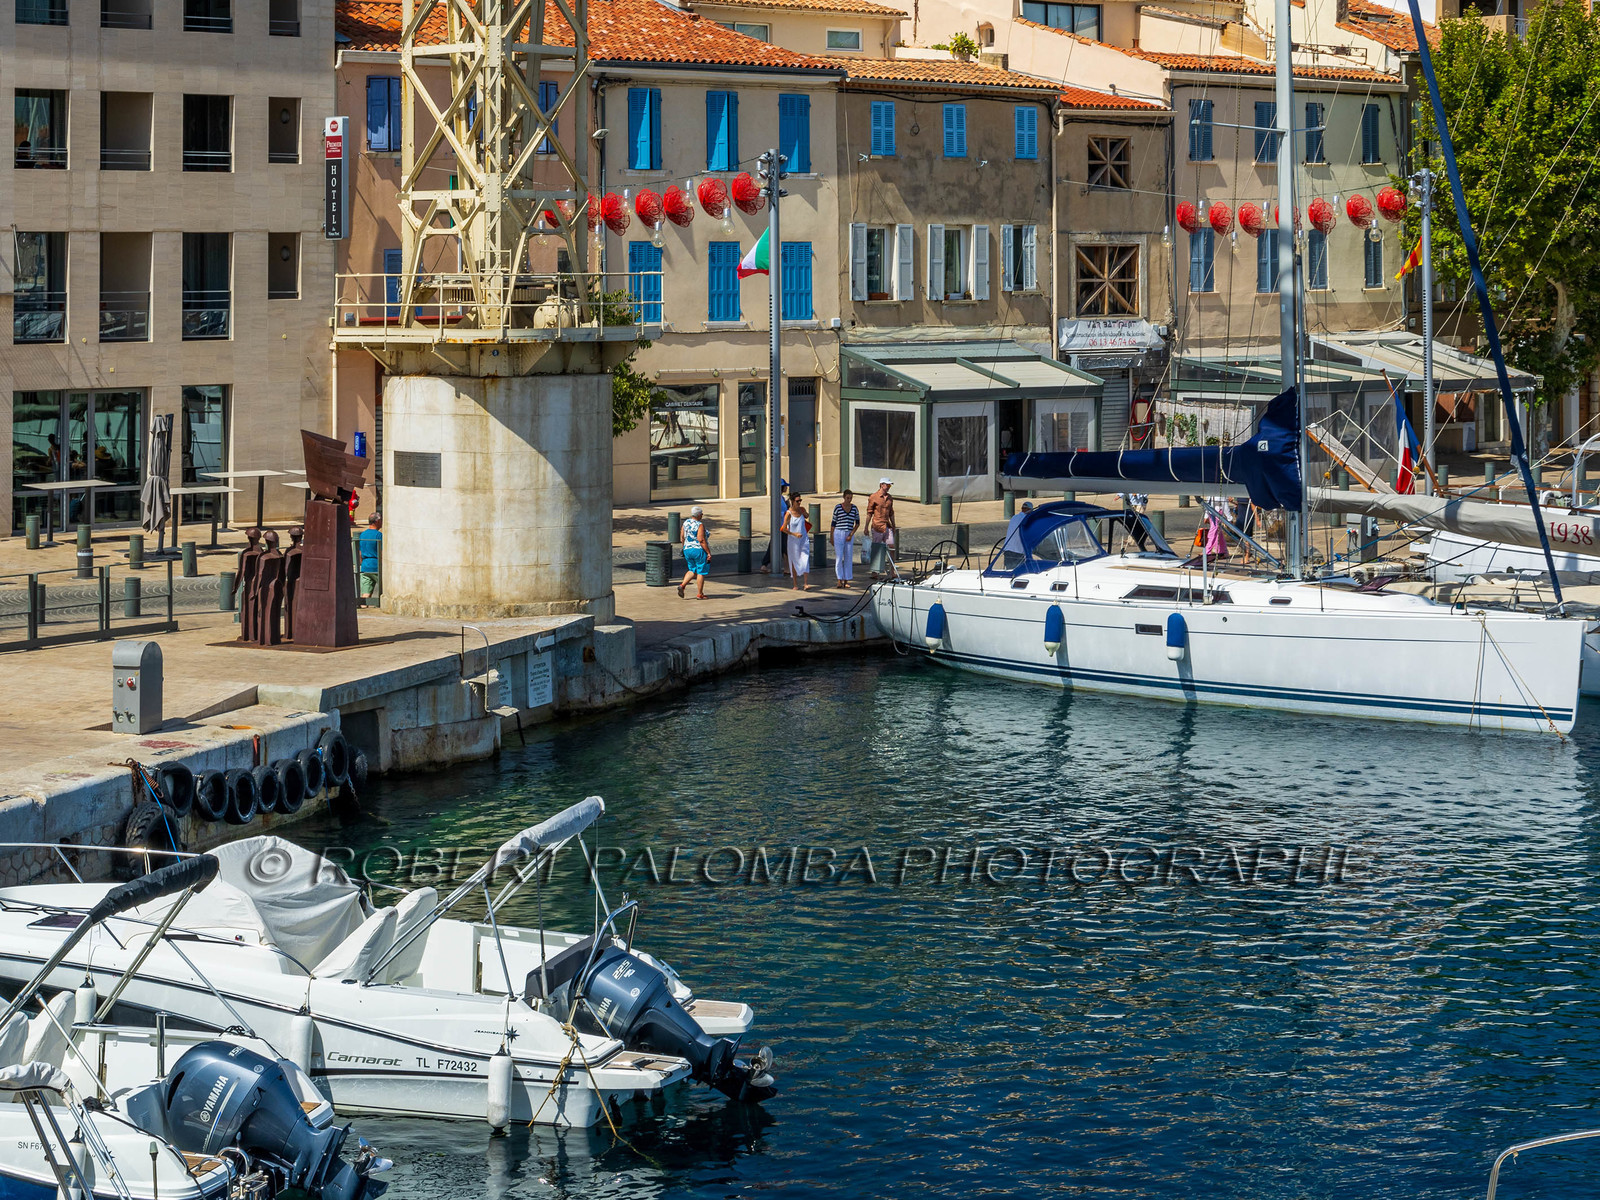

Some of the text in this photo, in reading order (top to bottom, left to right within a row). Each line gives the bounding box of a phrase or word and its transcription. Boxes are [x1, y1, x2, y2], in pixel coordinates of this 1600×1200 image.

[1088, 338, 1098, 347] 06
[1099, 338, 1107, 346] 13
[1550, 521, 1593, 546] 1938
[612, 959, 632, 980] 225
[326, 1051, 403, 1067] Camarat
[416, 1057, 478, 1073] TL F72432
[204, 1075, 229, 1113] YAMAHA
[17, 1141, 57, 1152] SN F672
